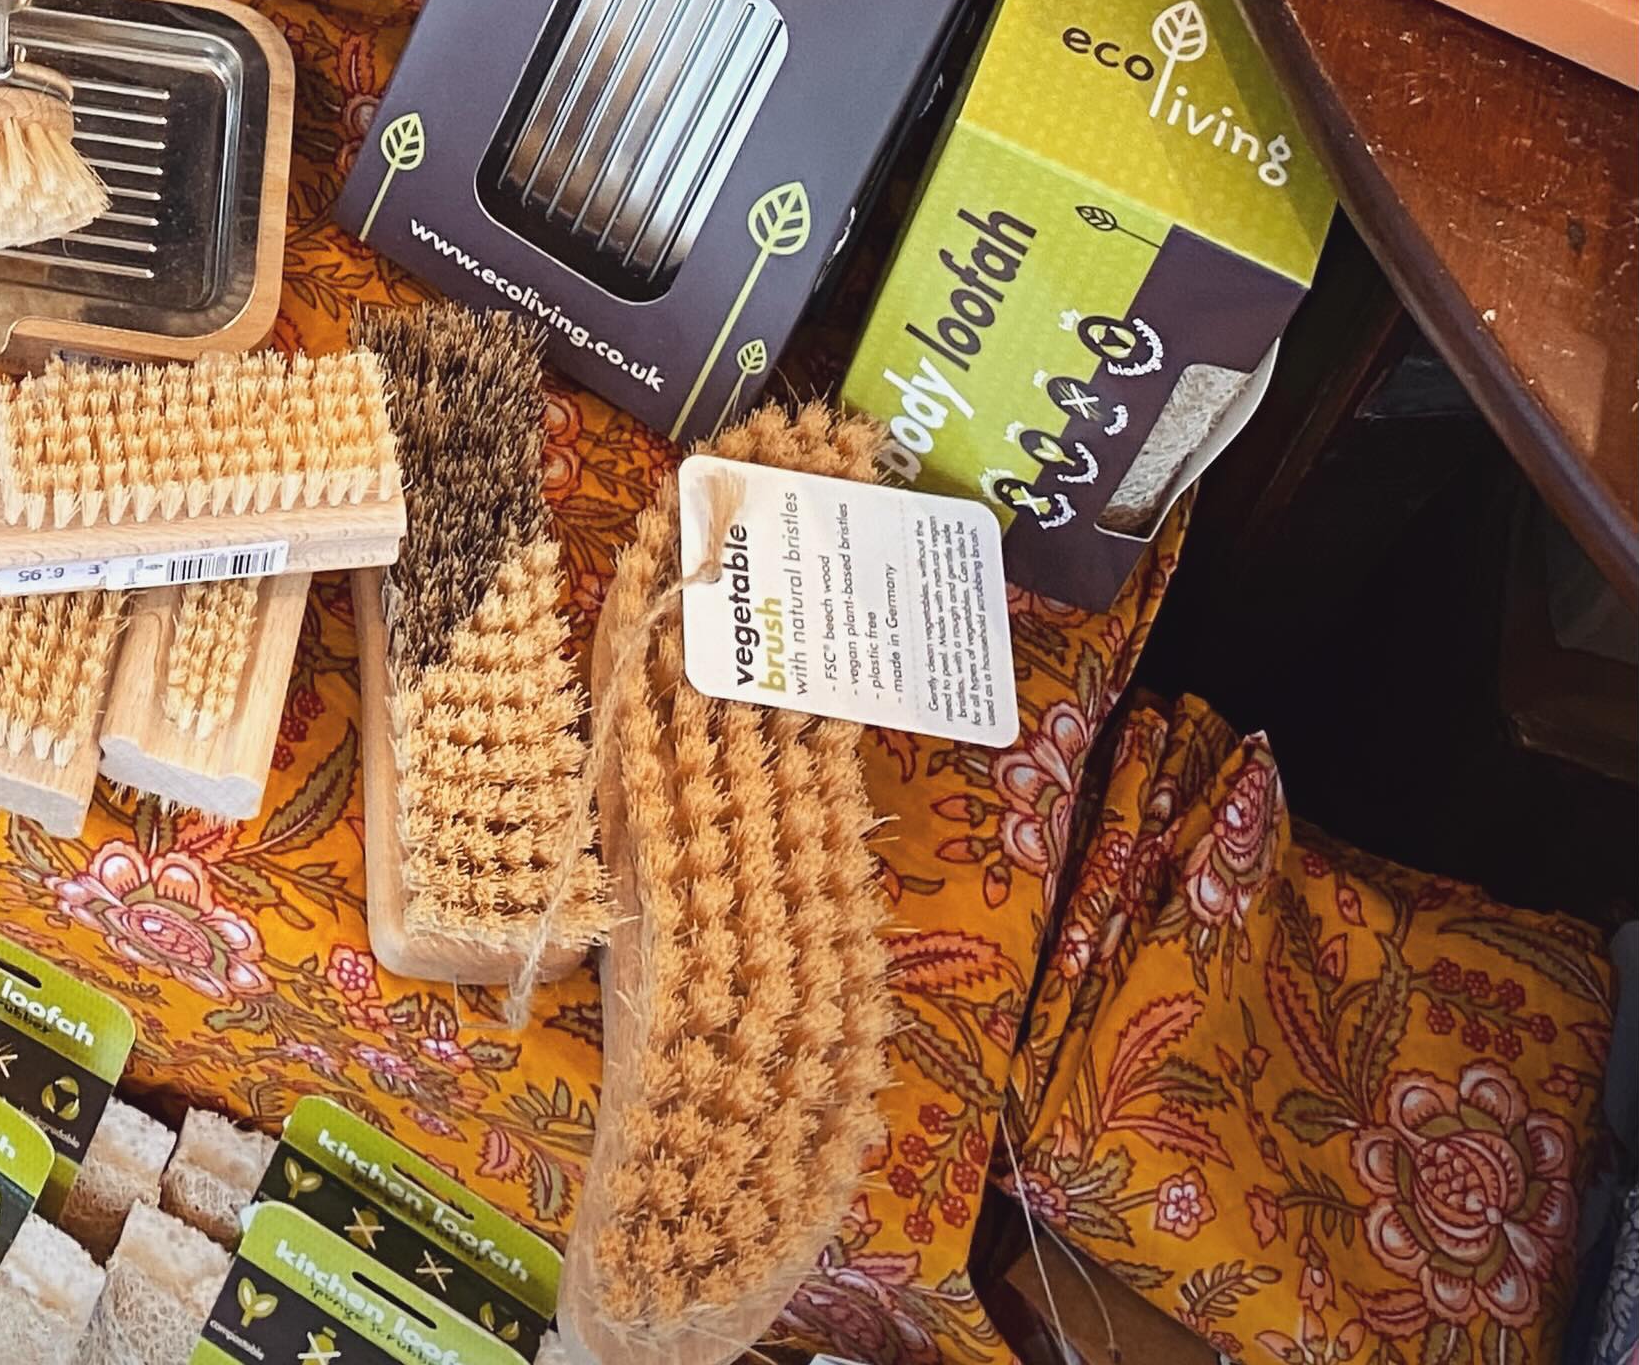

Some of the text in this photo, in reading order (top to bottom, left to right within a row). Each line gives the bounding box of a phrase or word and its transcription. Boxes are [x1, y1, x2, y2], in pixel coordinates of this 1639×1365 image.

[1062, 25, 1293, 188] eco living
[408, 216, 666, 394] www.ecoliving.co.uk
[904, 207, 1039, 373] loofah
[722, 523, 761, 687] vegetable
[757, 596, 787, 694] brush
[779, 491, 809, 698] with natural bristles
[883, 563, 904, 694] made in Germany
[0, 968, 97, 1049] loofah
[317, 1128, 531, 1284] kitchen loofah
